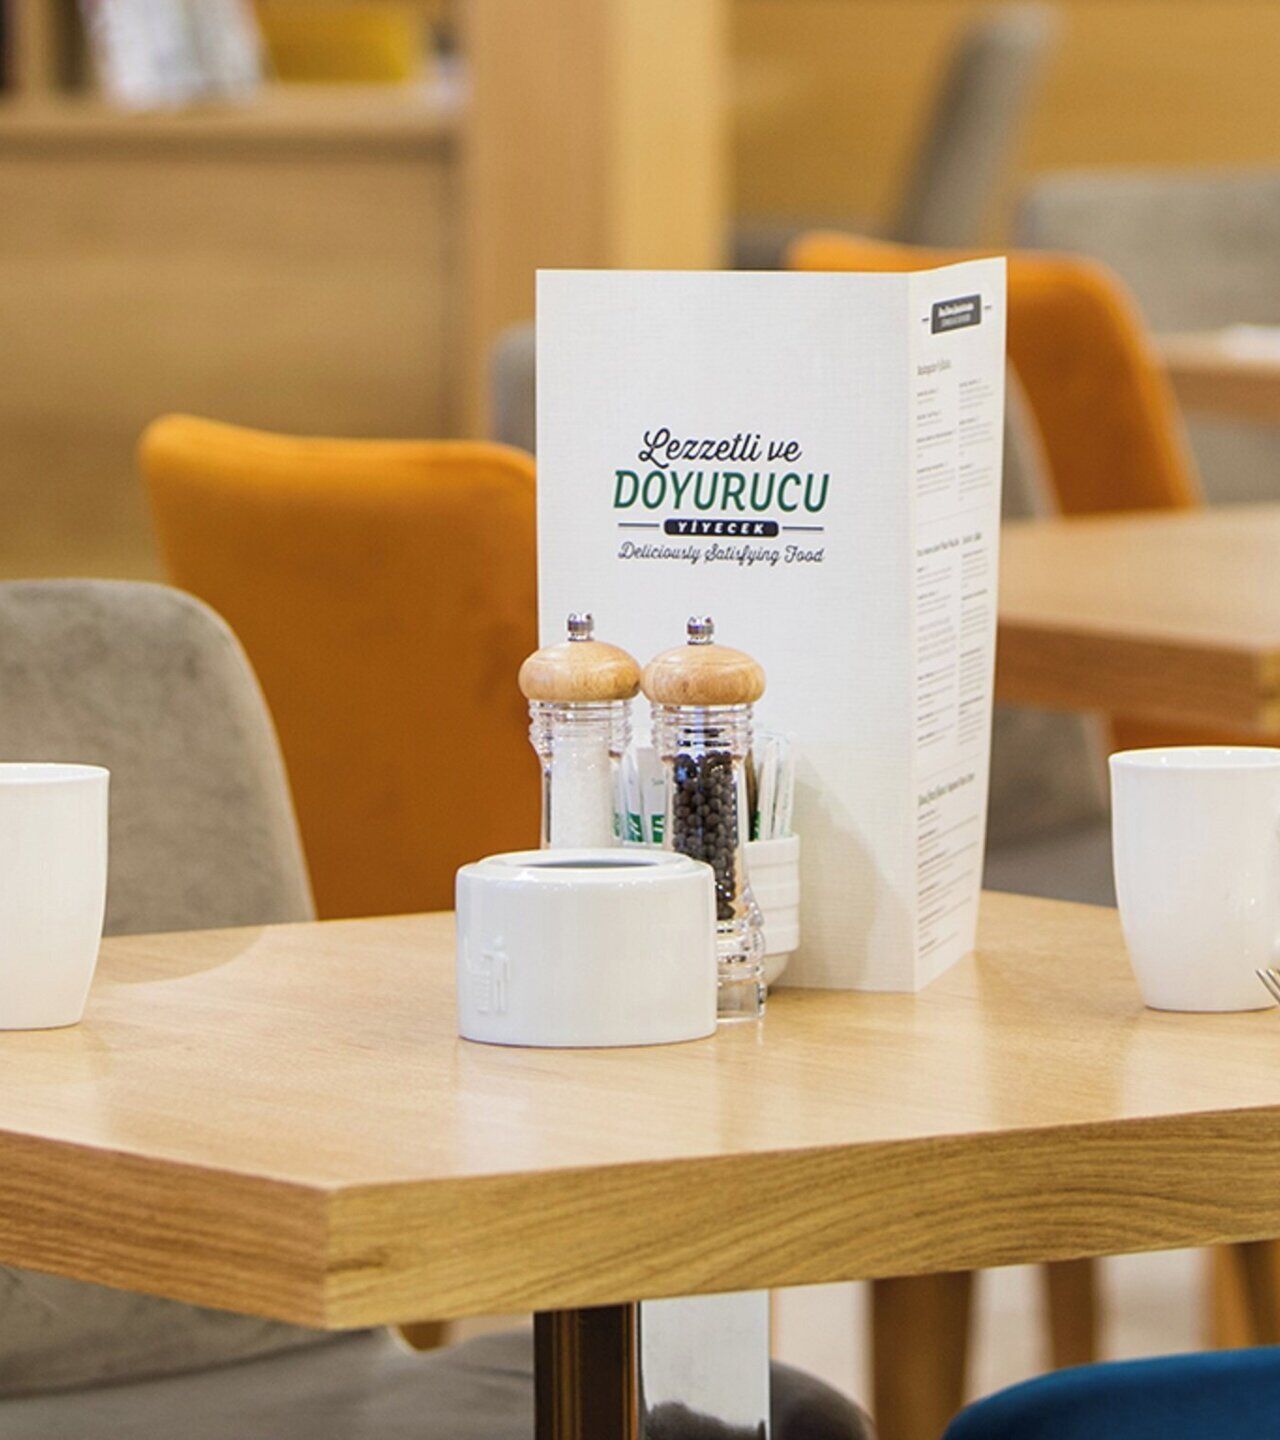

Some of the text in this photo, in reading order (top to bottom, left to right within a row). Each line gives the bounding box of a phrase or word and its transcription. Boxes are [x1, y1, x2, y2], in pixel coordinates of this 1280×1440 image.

[638, 427, 802, 469] Lezzetli ve
[613, 470, 830, 512] DOYURUCU
[677, 519, 765, 535] YİYECEK
[618, 541, 825, 566] Deliciously Satisfying Food
